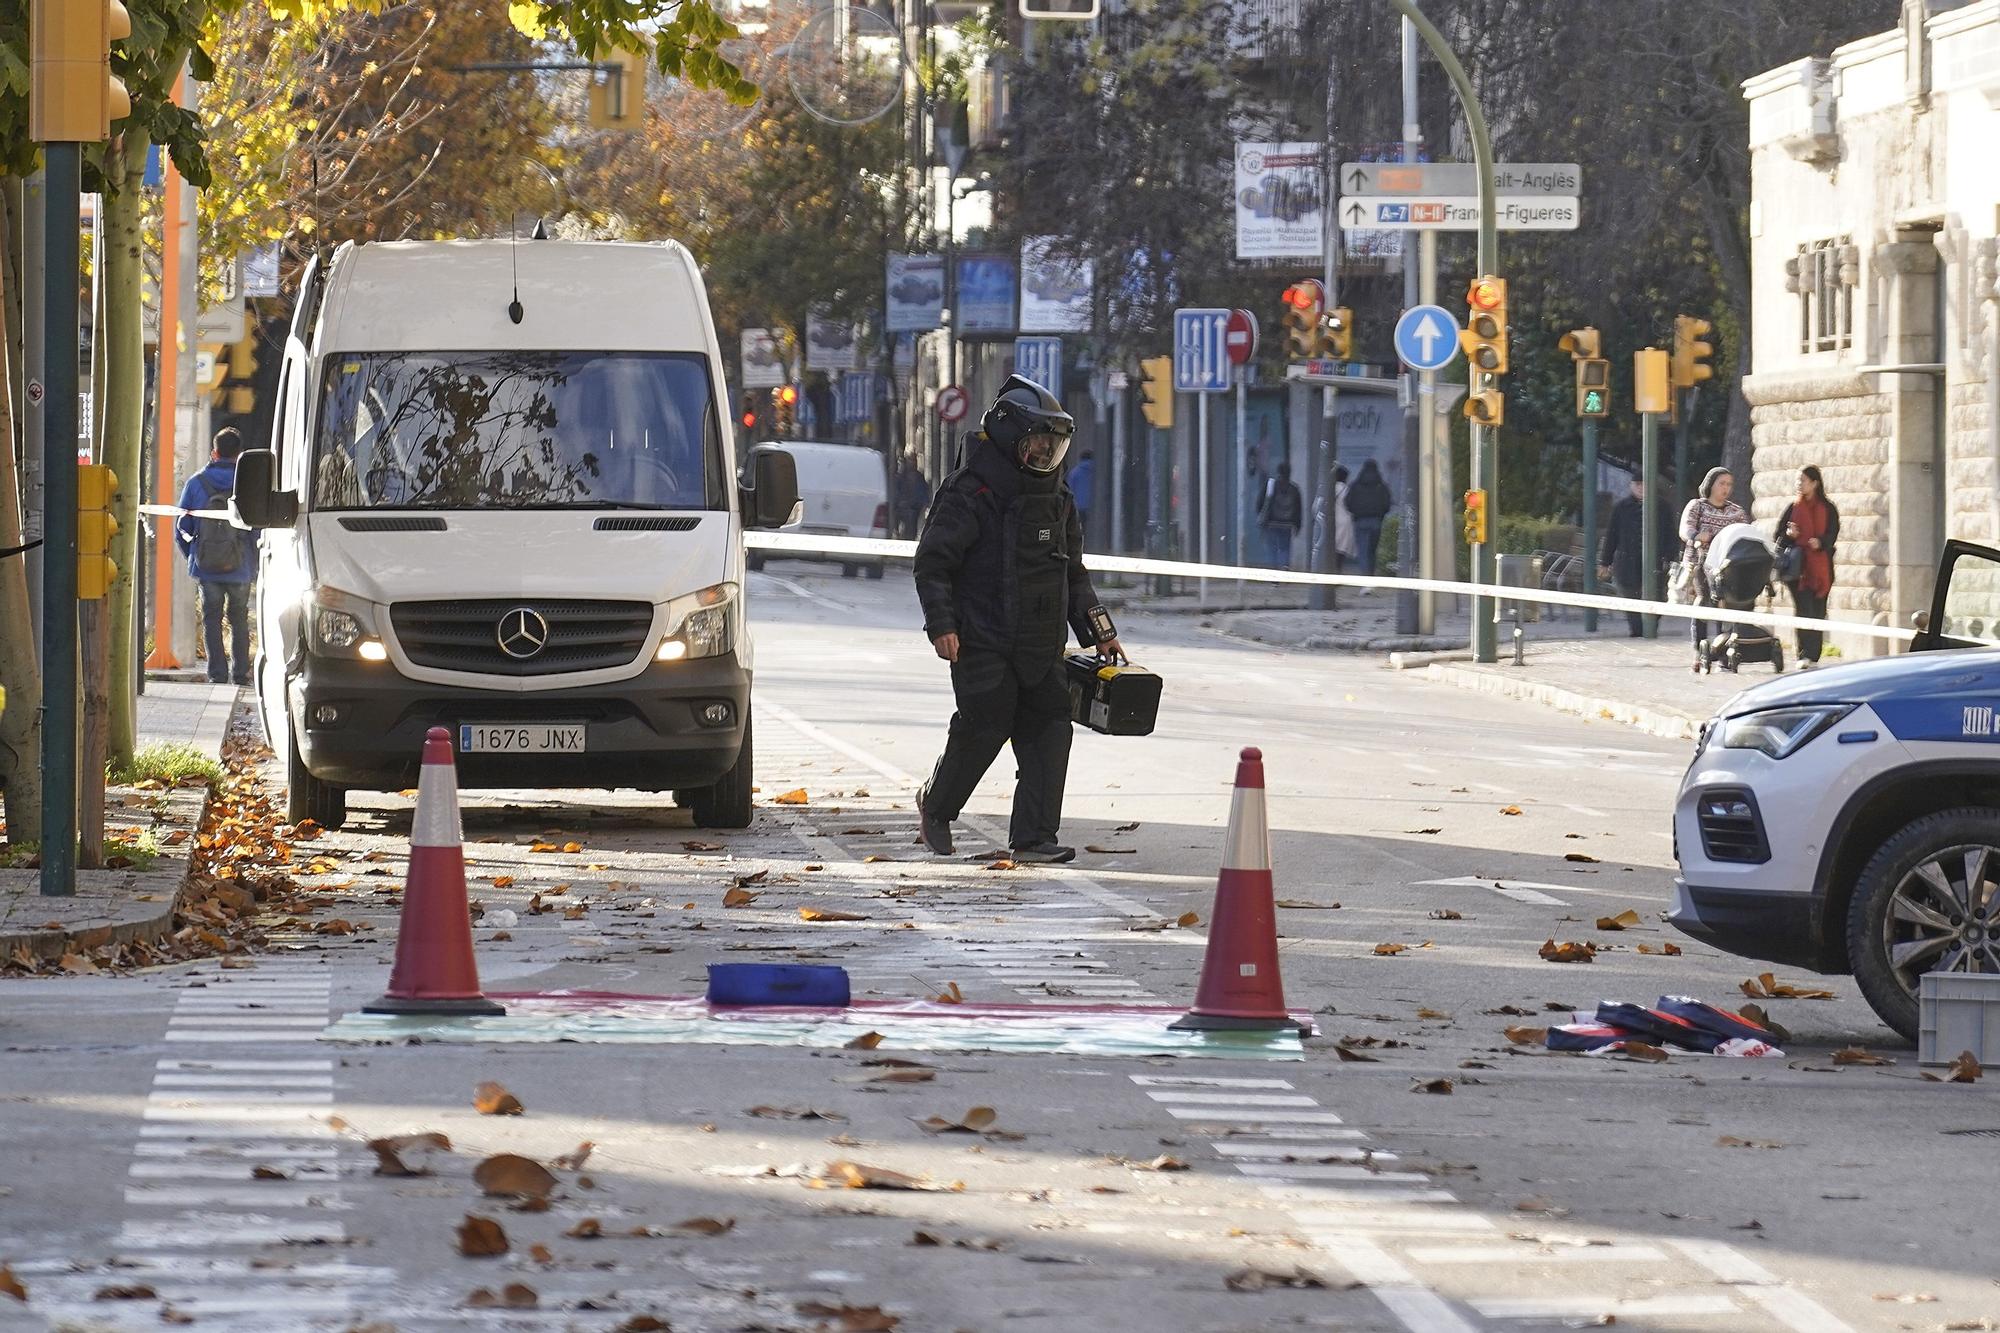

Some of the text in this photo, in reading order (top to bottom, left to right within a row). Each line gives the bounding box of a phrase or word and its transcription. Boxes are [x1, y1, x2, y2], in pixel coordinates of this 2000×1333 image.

[1494, 171, 1575, 192] alt-Anglès
[1380, 206, 1408, 221] A-7
[1443, 204, 1573, 223] Fran-Figueres
[478, 729, 530, 749] 1676
[540, 729, 579, 749] JNX
